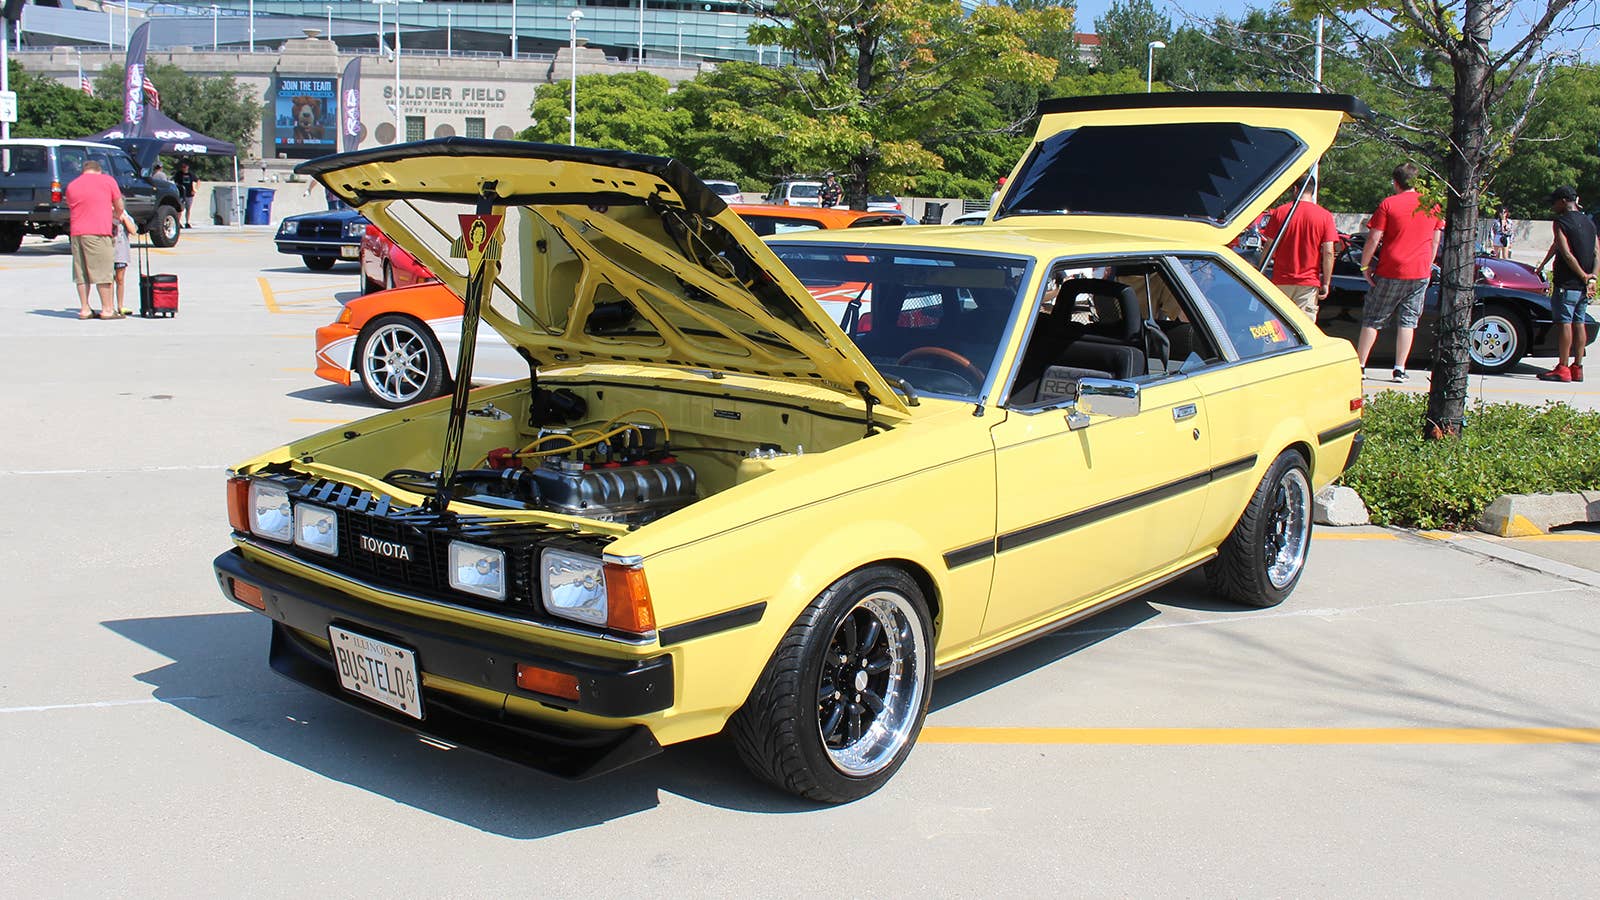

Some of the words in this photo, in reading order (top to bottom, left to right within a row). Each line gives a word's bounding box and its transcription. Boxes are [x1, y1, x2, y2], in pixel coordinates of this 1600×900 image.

[281, 80, 298, 91] JOIN
[299, 80, 312, 91] THE
[313, 80, 332, 91] TEAM
[383, 86, 452, 100] SOLDIER
[462, 88, 505, 101] FIELD
[1044, 379, 1076, 395] REC
[361, 535, 409, 560] TOYOTA
[353, 637, 392, 657] ILLINOIS
[337, 646, 406, 699] BUSTELO
